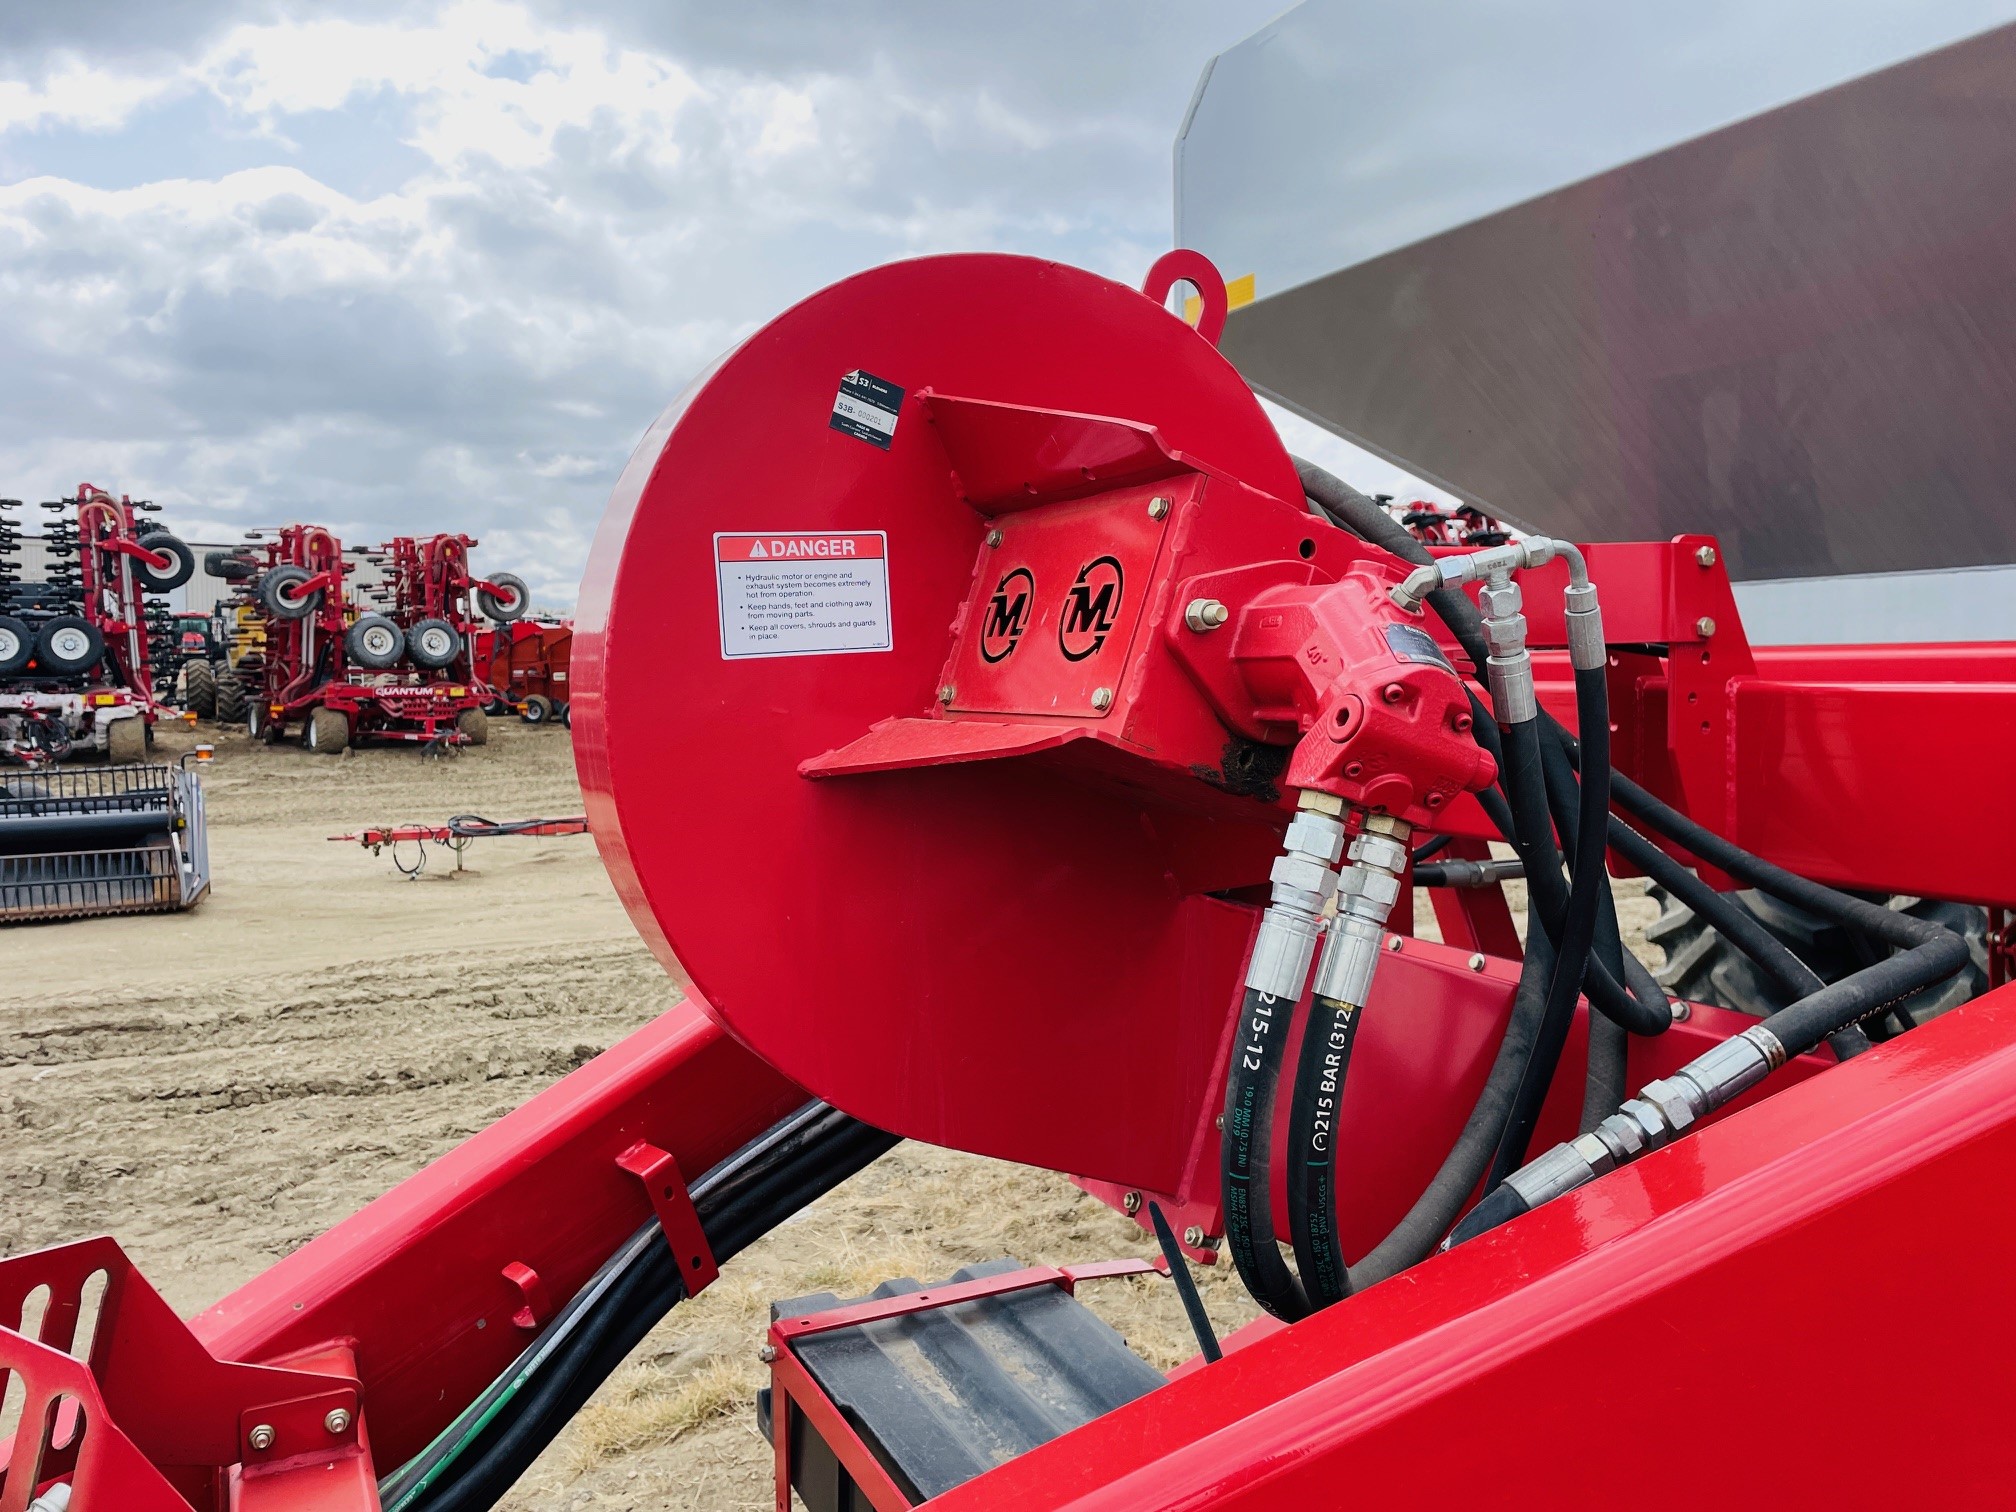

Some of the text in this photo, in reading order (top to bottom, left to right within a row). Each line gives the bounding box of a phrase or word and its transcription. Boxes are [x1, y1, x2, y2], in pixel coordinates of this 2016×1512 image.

[858, 377, 870, 387] S3
[770, 539, 856, 557] DANGER
[745, 574, 780, 583] Hydraulic
[745, 582, 775, 590] exhaust
[776, 582, 803, 590] system
[837, 580, 872, 588] extremely
[747, 603, 767, 611] Keep
[768, 602, 793, 610] hands,
[825, 600, 854, 608] clothing
[854, 600, 873, 608] away
[766, 611, 793, 619] moving
[794, 610, 815, 618] parts.
[807, 621, 837, 629] shrouds
[837, 620, 852, 628] and
[852, 620, 877, 628] guards
[375, 687, 434, 697] QUANTUM
[1242, 990, 1277, 1072] 215-12
[1320, 1054, 1342, 1094] BAR
[1314, 1097, 1334, 1132] 215
[1232, 1107, 1243, 1137] DN19
[1237, 1085, 1255, 1168] 19.0 MM (0.75 IN)
[1309, 1212, 1320, 1237] 18752
